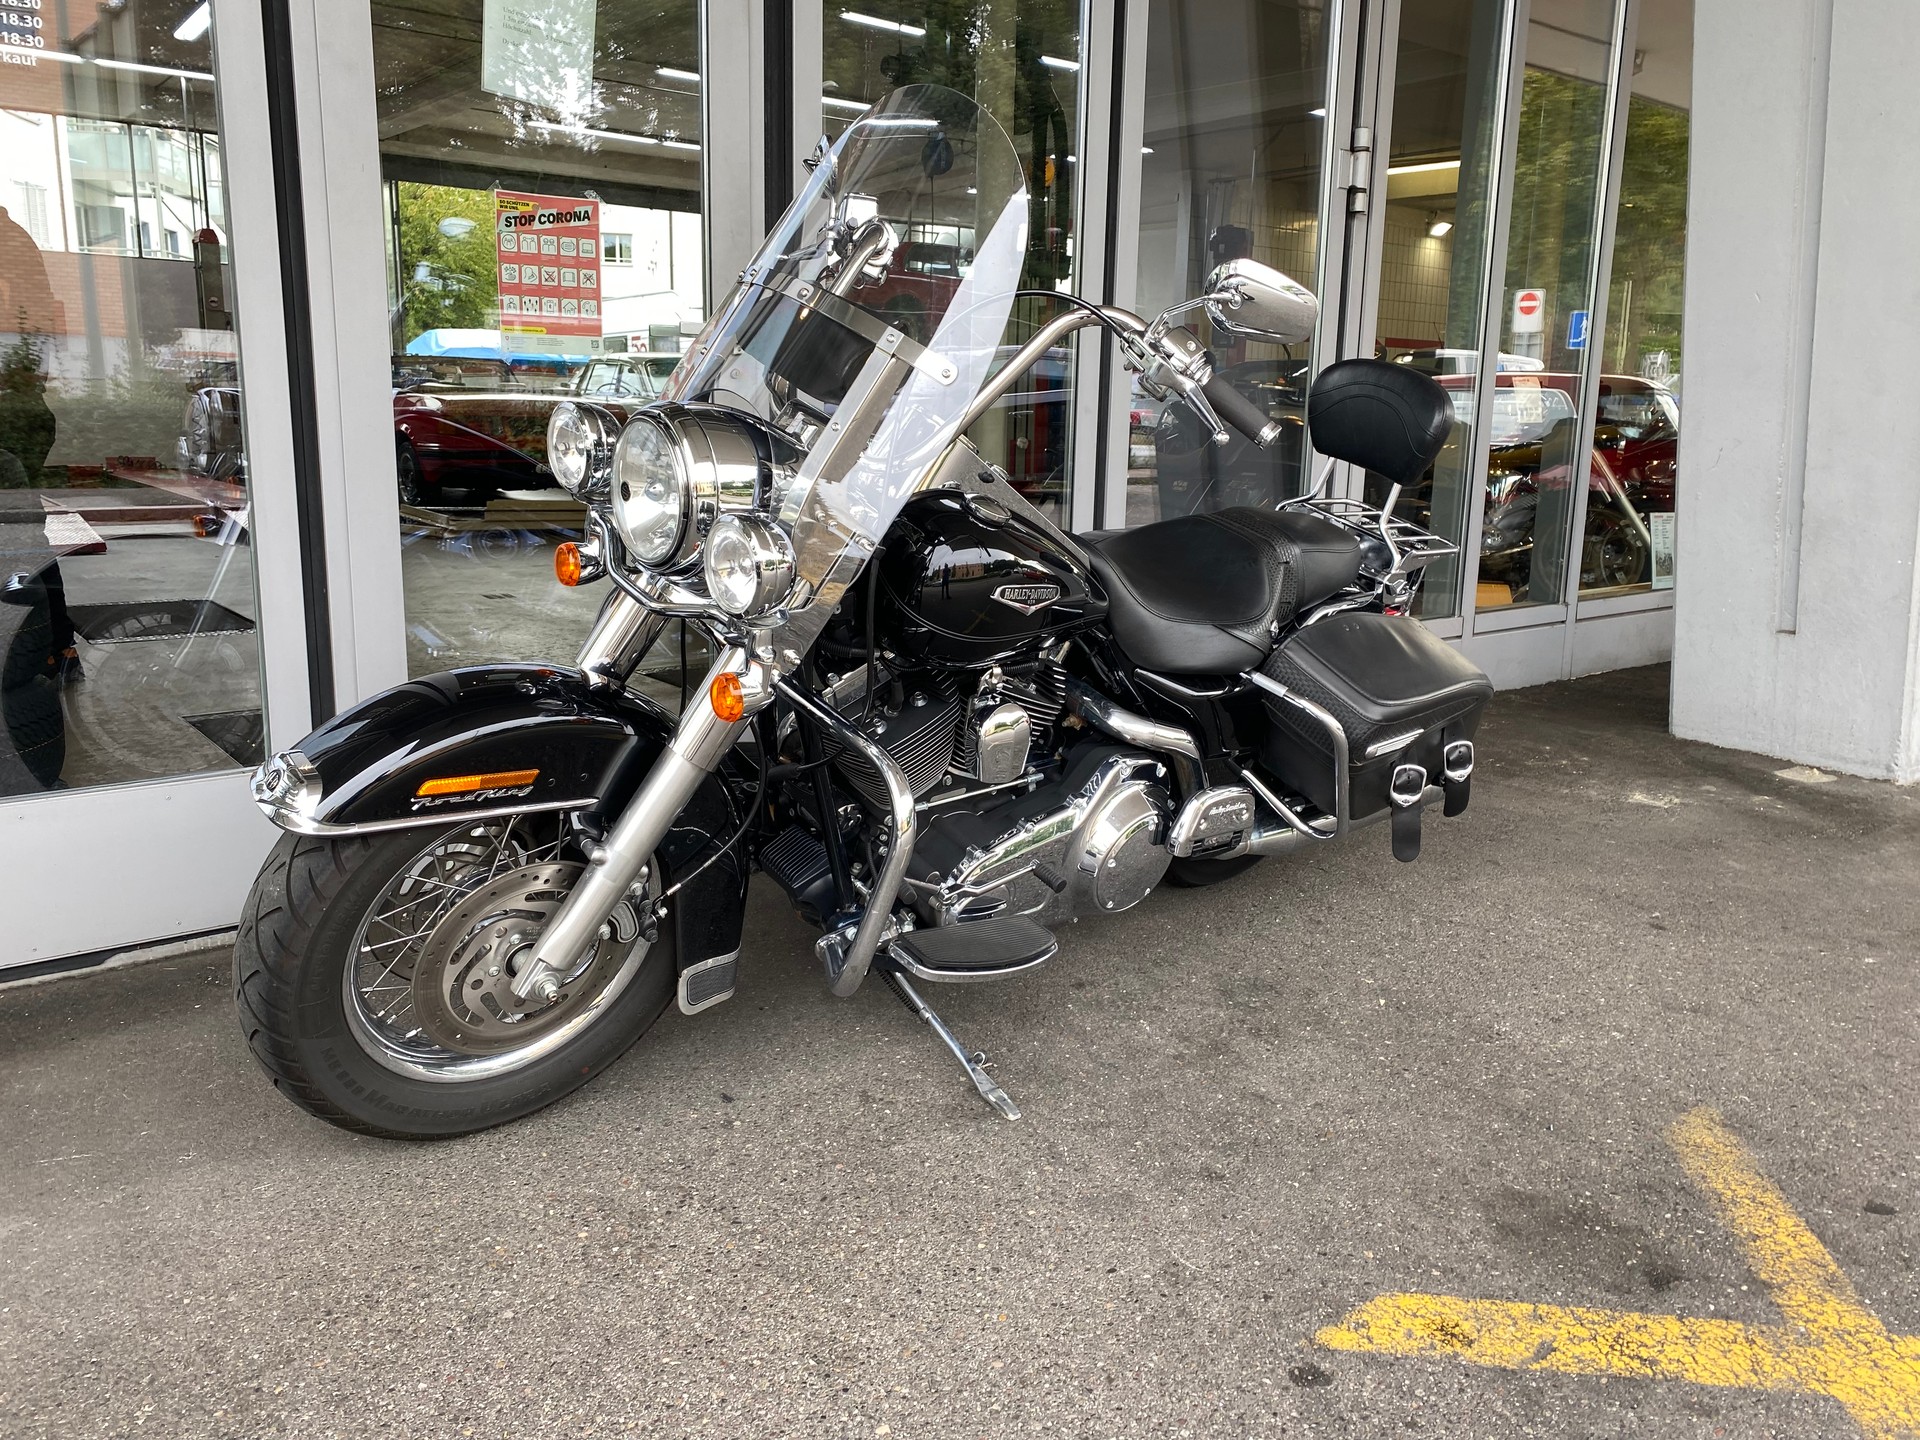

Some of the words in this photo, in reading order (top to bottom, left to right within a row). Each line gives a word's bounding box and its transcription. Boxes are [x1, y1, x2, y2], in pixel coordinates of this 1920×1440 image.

[0, 12, 43, 29] 18.30
[1, 31, 44, 48] 18.30
[0, 51, 37, 67] kauf
[504, 214, 536, 228] STOP
[538, 209, 591, 225] CORONA
[1004, 588, 1056, 600] HARLEY-DAVIDSON
